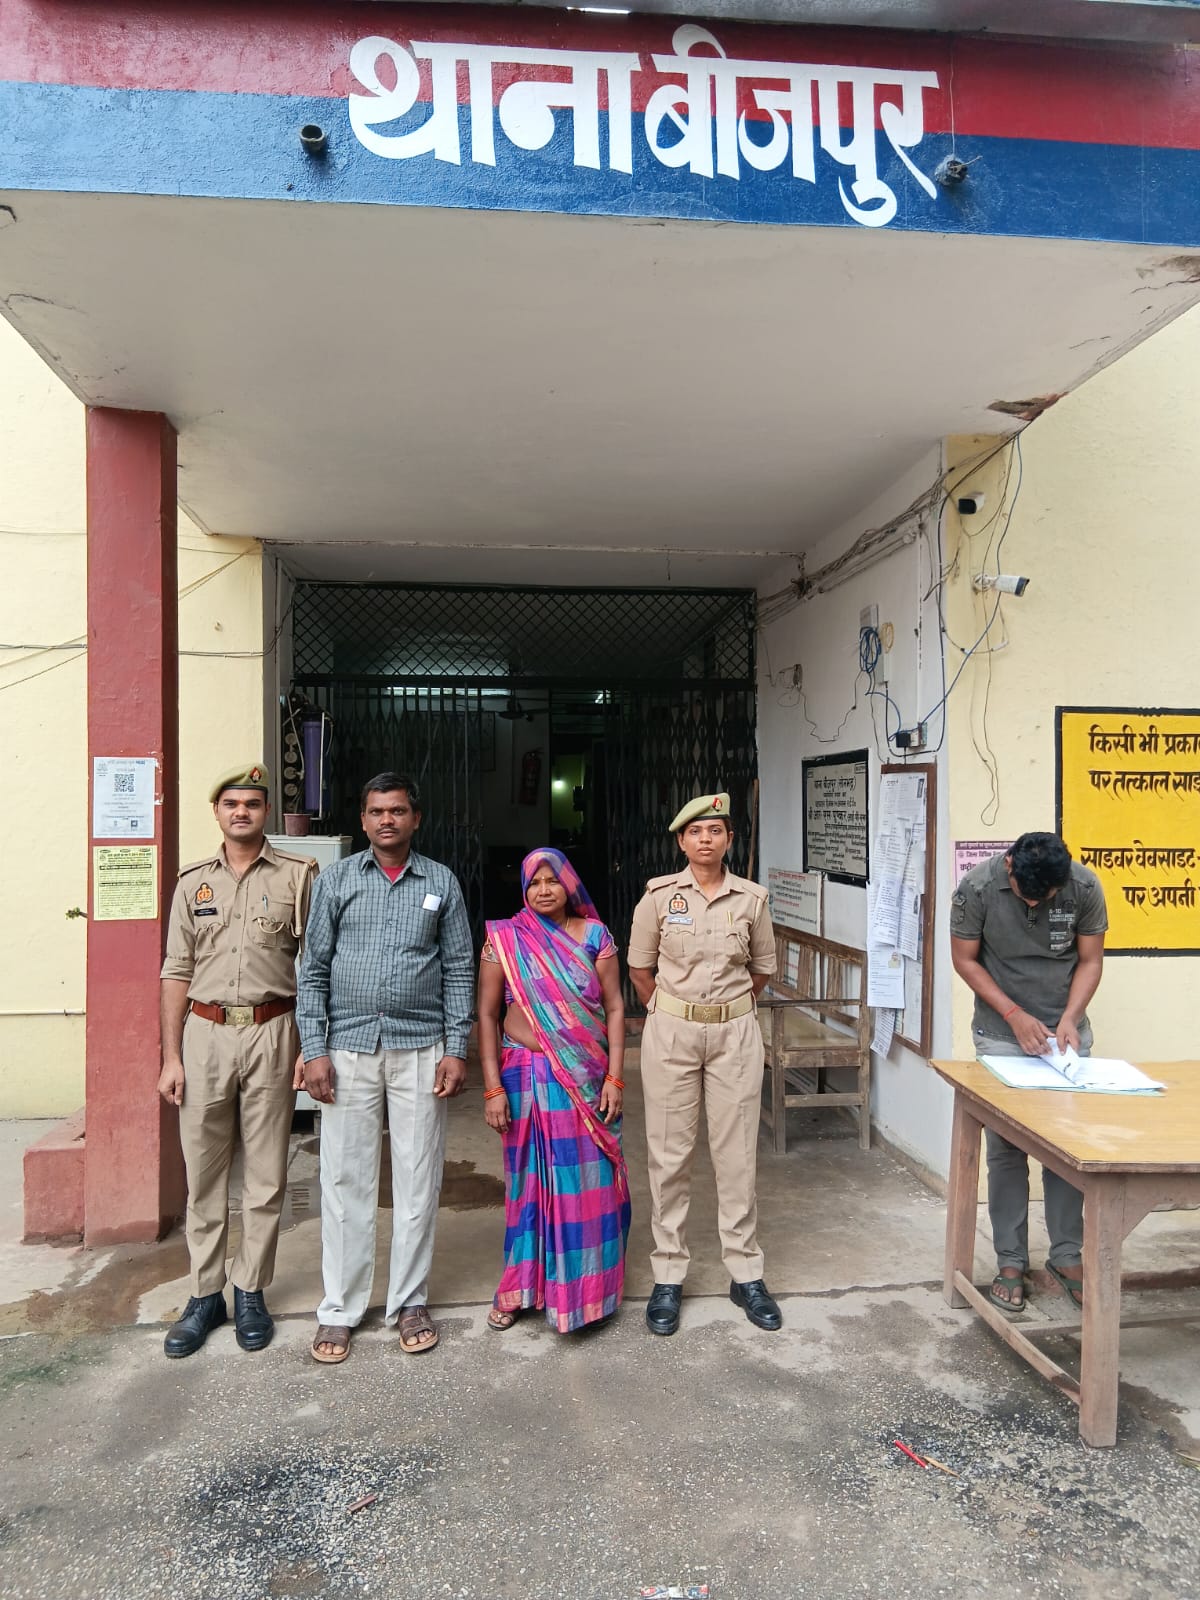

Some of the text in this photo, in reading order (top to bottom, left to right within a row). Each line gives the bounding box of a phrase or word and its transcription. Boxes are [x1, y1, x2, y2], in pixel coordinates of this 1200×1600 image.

[349, 23, 940, 228] थाना बीजपुर
[1087, 724, 1200, 757] किसी भी प्रका
[1088, 770, 1115, 798] पर
[1113, 770, 1171, 799] तत्काल
[1080, 847, 1135, 872] साइबर
[1121, 877, 1197, 914] पर अपनी
